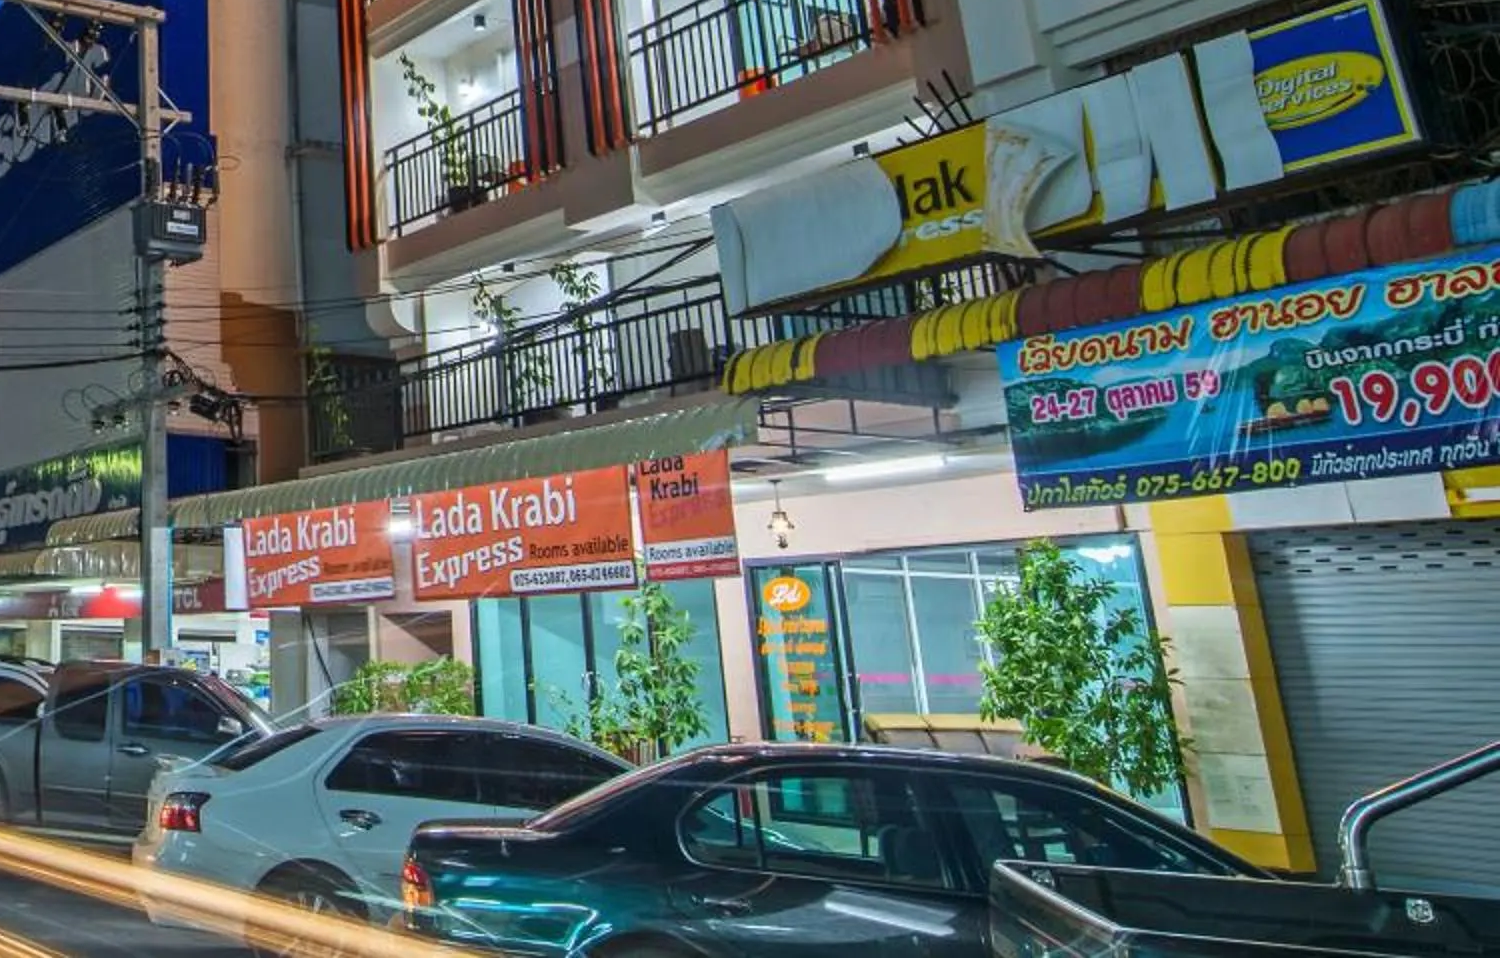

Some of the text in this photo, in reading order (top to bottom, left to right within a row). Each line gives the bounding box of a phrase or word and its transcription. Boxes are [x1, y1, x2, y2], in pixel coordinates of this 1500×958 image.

[1257, 61, 1338, 98] Digital
[1017, 316, 1194, 376] เวียดนาม
[1209, 283, 1365, 341] ฮานอย
[1305, 317, 1466, 370] บินจากกระบี่
[1031, 386, 1098, 423] 24-27
[1106, 377, 1177, 421] ตุลาคม
[650, 471, 699, 500] Krabi
[1135, 458, 1301, 499] 075-667-800
[415, 476, 577, 541] Lada Krabi
[245, 507, 357, 557] Lada Krabi
[529, 533, 630, 560] Rooms available
[248, 554, 322, 599] Express
[417, 534, 523, 590] Express
